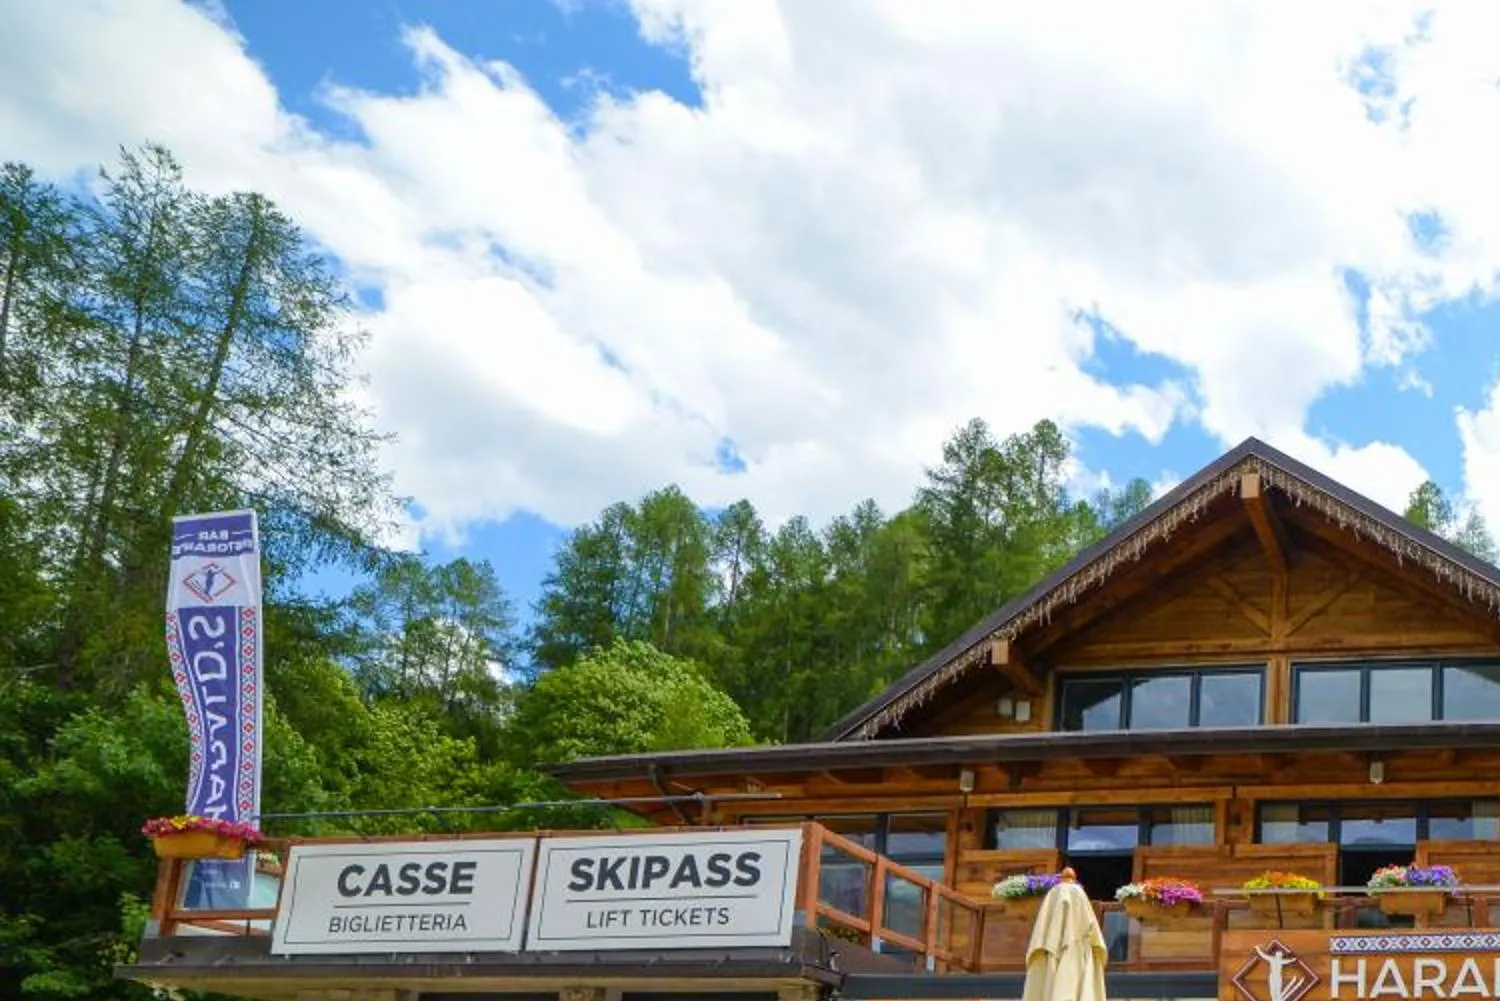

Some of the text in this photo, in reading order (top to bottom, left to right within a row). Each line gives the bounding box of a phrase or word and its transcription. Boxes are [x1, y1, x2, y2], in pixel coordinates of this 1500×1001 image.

[337, 861, 477, 898] CASSE
[567, 852, 762, 892] SKIPASS
[328, 914, 467, 933] BIGLIETTERIA
[586, 907, 730, 929] LIFT TICKETS
